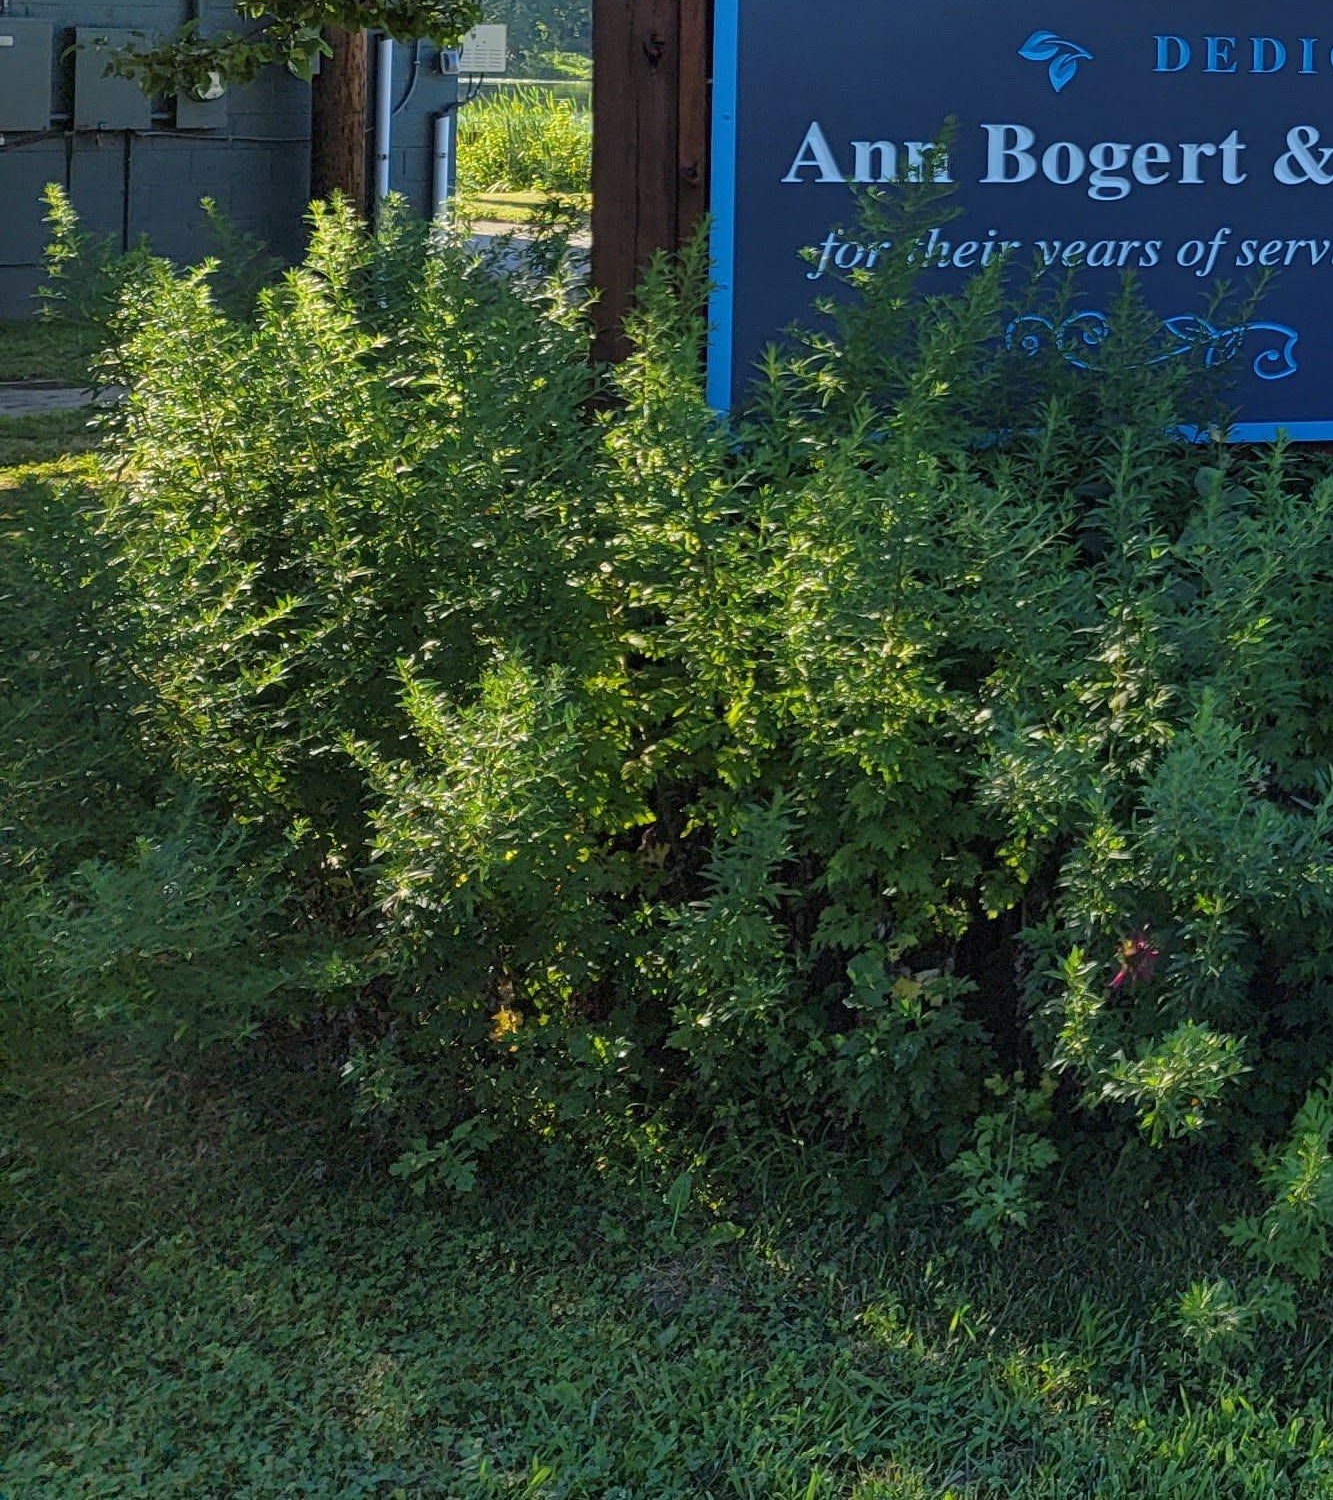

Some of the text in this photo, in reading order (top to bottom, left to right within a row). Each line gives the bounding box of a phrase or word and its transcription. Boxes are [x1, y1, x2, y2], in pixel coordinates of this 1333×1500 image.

[780, 120, 955, 184] Ann
[978, 123, 1247, 201] Bogert
[806, 229, 892, 280] for
[1176, 227, 1232, 277] of
